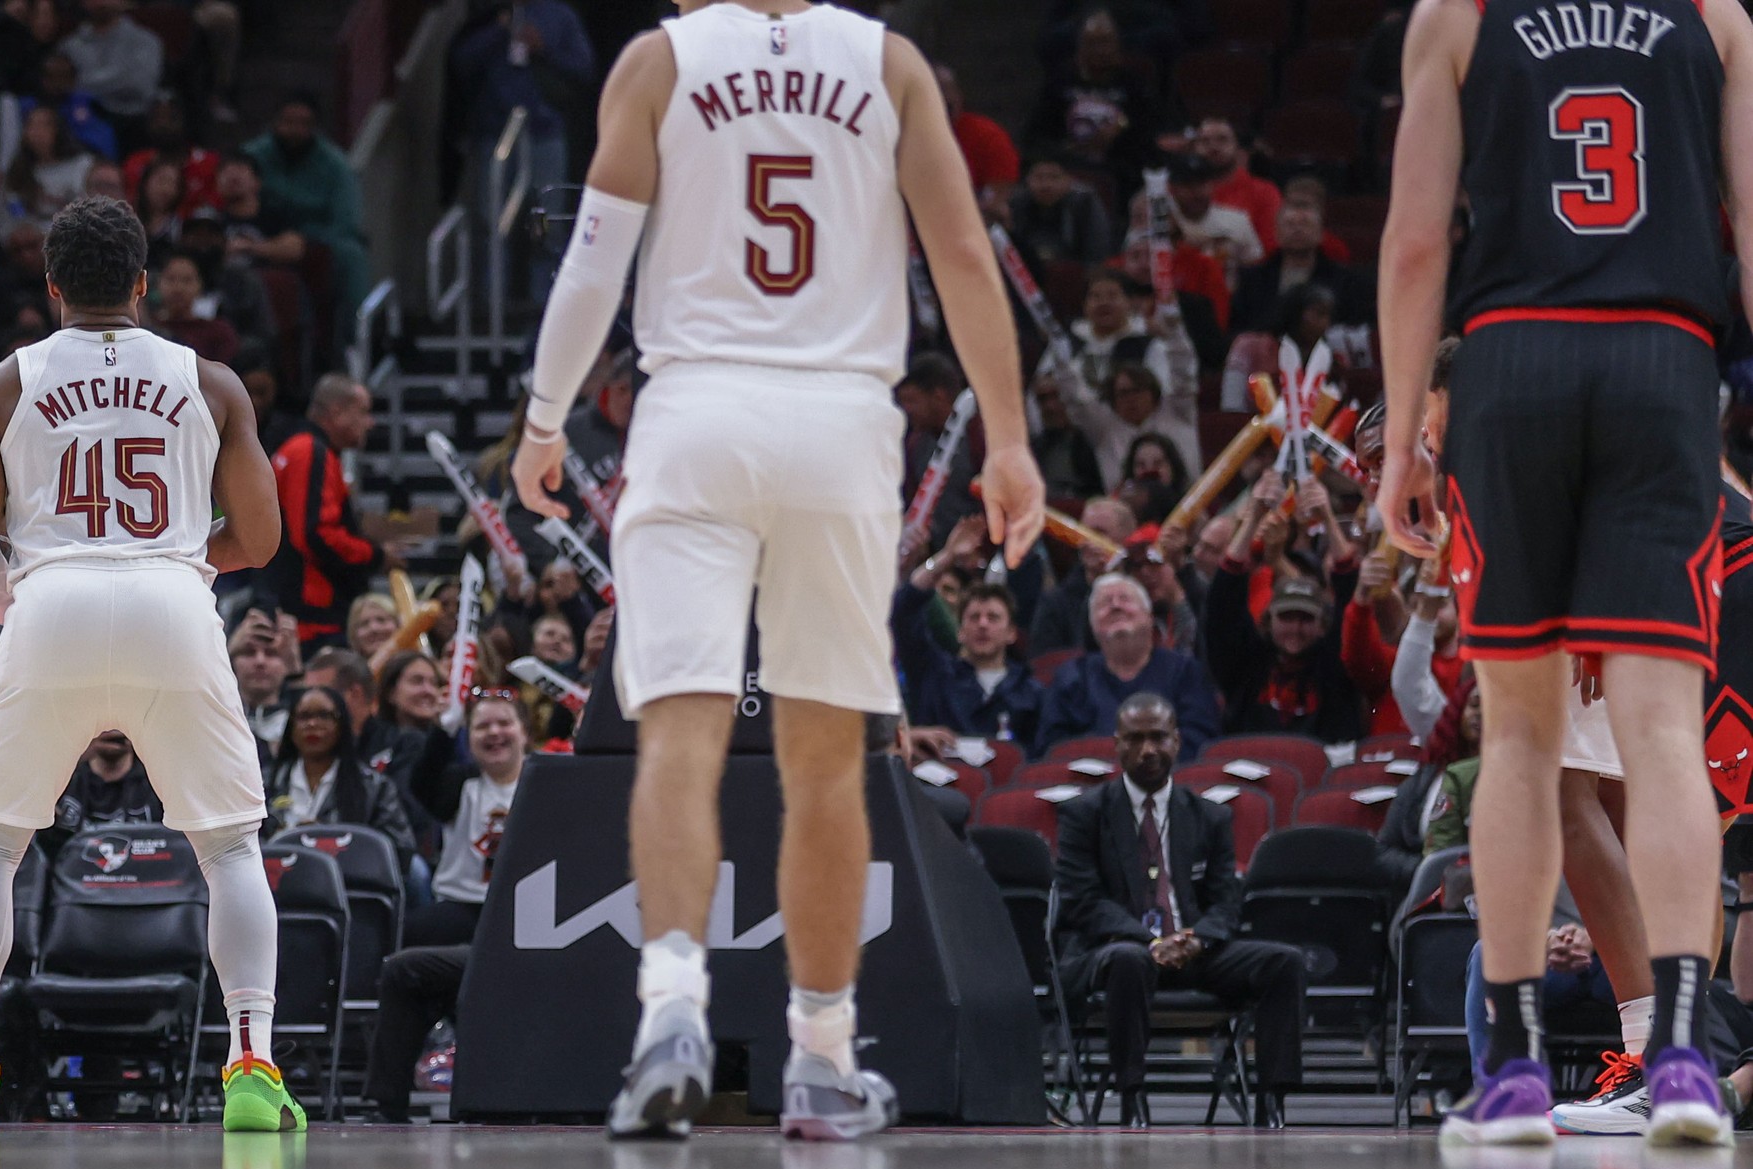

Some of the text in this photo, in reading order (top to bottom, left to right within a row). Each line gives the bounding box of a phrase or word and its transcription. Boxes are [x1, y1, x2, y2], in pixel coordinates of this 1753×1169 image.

[1512, 1, 1677, 60] GIDDEY
[689, 69, 873, 137] MERRILL
[1548, 86, 1647, 235] 3
[744, 154, 815, 297] 5
[34, 376, 189, 430] MITCHELL
[54, 436, 169, 539] 45
